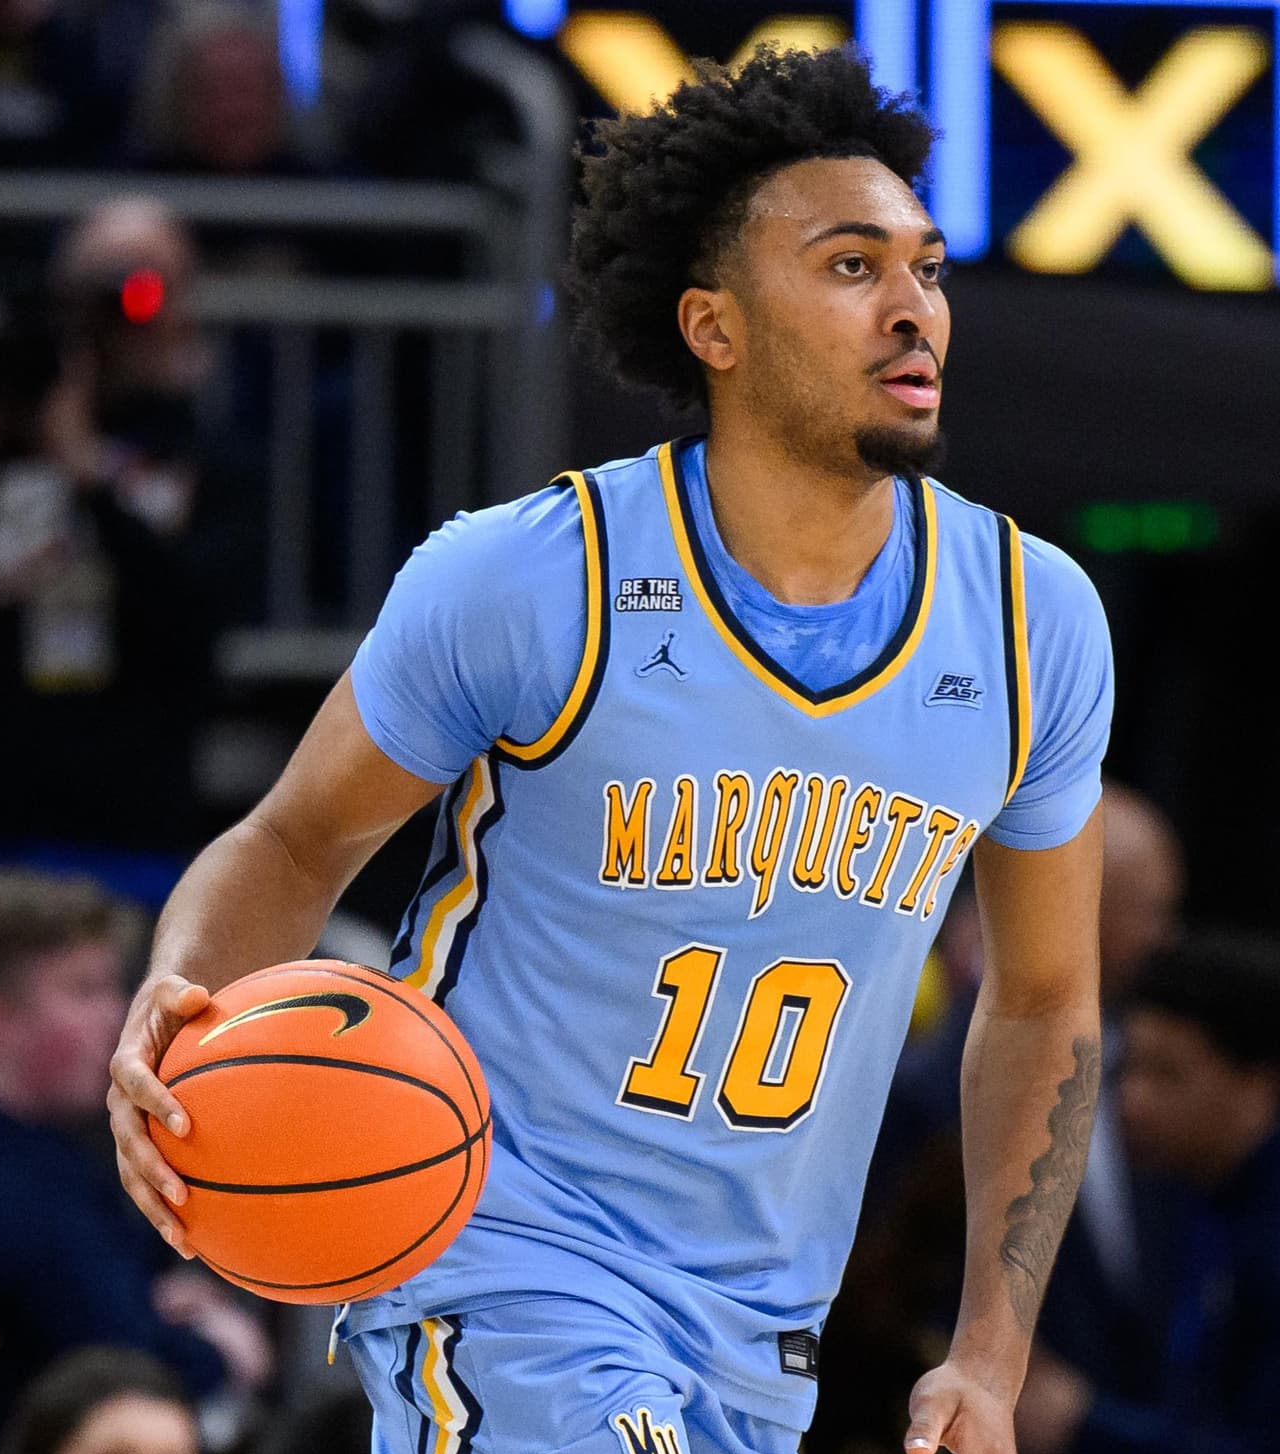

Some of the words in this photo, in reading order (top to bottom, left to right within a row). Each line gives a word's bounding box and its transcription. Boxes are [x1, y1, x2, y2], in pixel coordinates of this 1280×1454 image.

[621, 580, 643, 595] BE
[648, 579, 677, 595] THE
[616, 595, 681, 610] CHANGE
[939, 674, 975, 688] BIG
[934, 685, 983, 700] EAST
[616, 942, 853, 1134] 10
